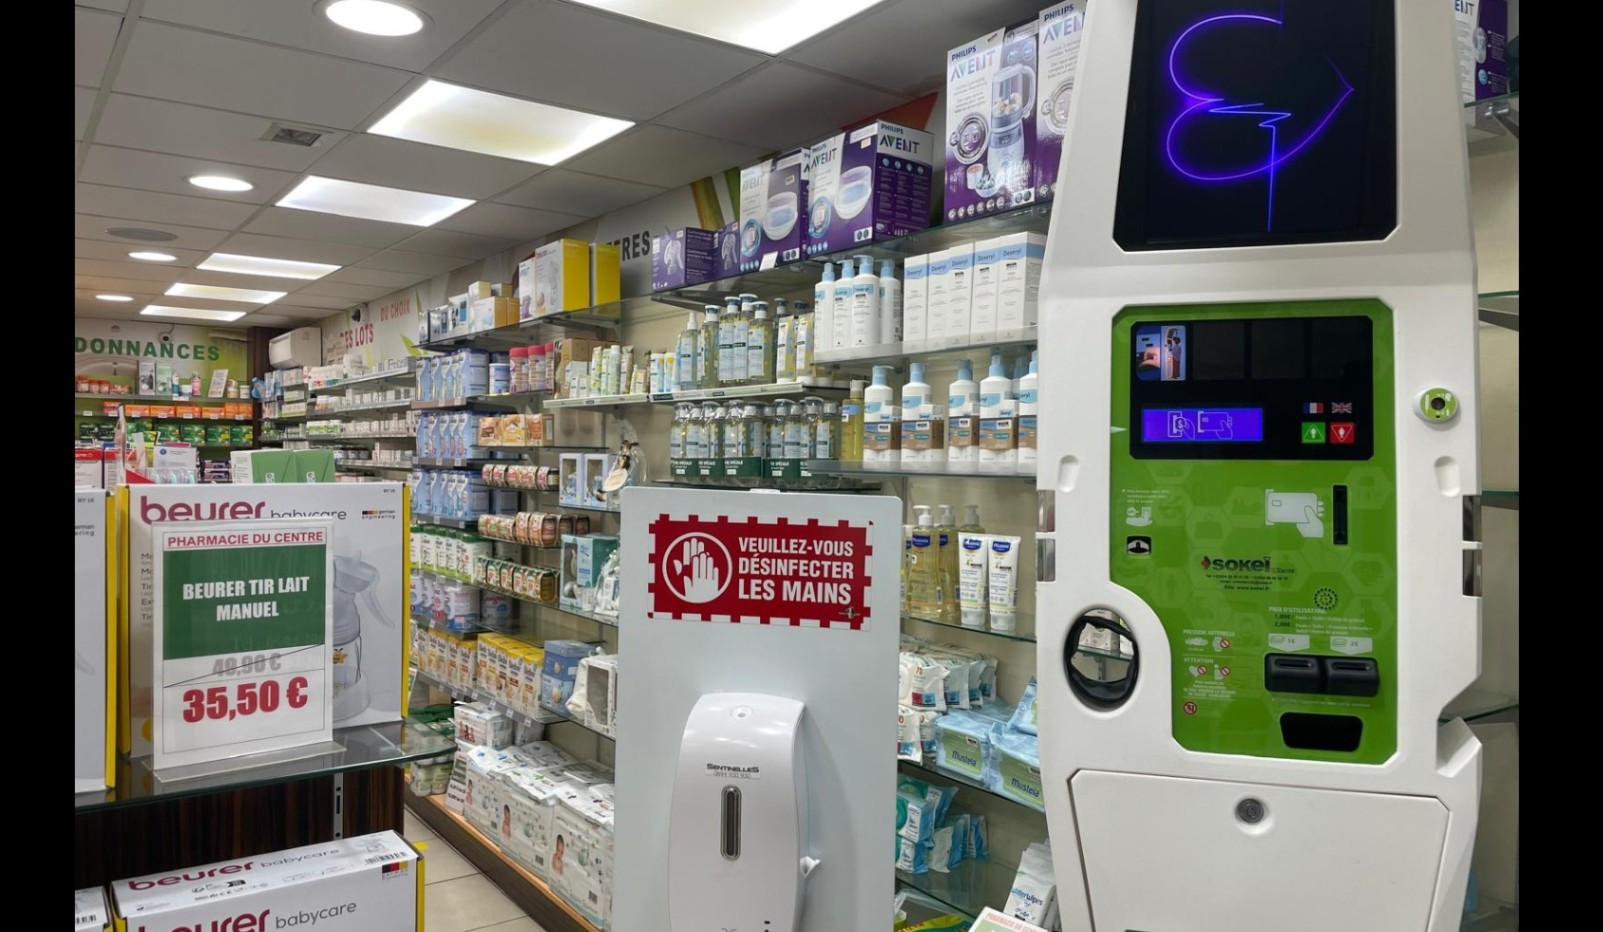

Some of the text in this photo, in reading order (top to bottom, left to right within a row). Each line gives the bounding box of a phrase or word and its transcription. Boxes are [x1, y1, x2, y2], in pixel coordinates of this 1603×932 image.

[1044, 3, 1074, 22] PHILIPS
[1043, 11, 1086, 44] AVEN
[951, 45, 977, 62] PHILIPS
[951, 49, 995, 82] AVENT
[880, 122, 904, 135] PHILIPS
[879, 134, 920, 155] AVENT
[810, 147, 838, 169] AVENT
[355, 322, 374, 347] LOTS
[140, 496, 266, 525] beurer
[167, 531, 323, 548] PHARMACIE DU CENTRE
[738, 536, 855, 558] VEUILLEZ-VOUS
[738, 553, 854, 580] DÉSINFECTER
[182, 576, 311, 601] BEURER TIR LAIT
[738, 578, 852, 605] LES MAINS
[215, 601, 280, 622] MANUEL
[270, 652, 281, 671] €
[182, 676, 309, 724] 35,50 €
[952, 750, 977, 767] Mustela
[1011, 777, 1039, 798] Mustela
[128, 861, 254, 891] beurer
[260, 849, 340, 868] babycare
[275, 902, 357, 930] babycare
